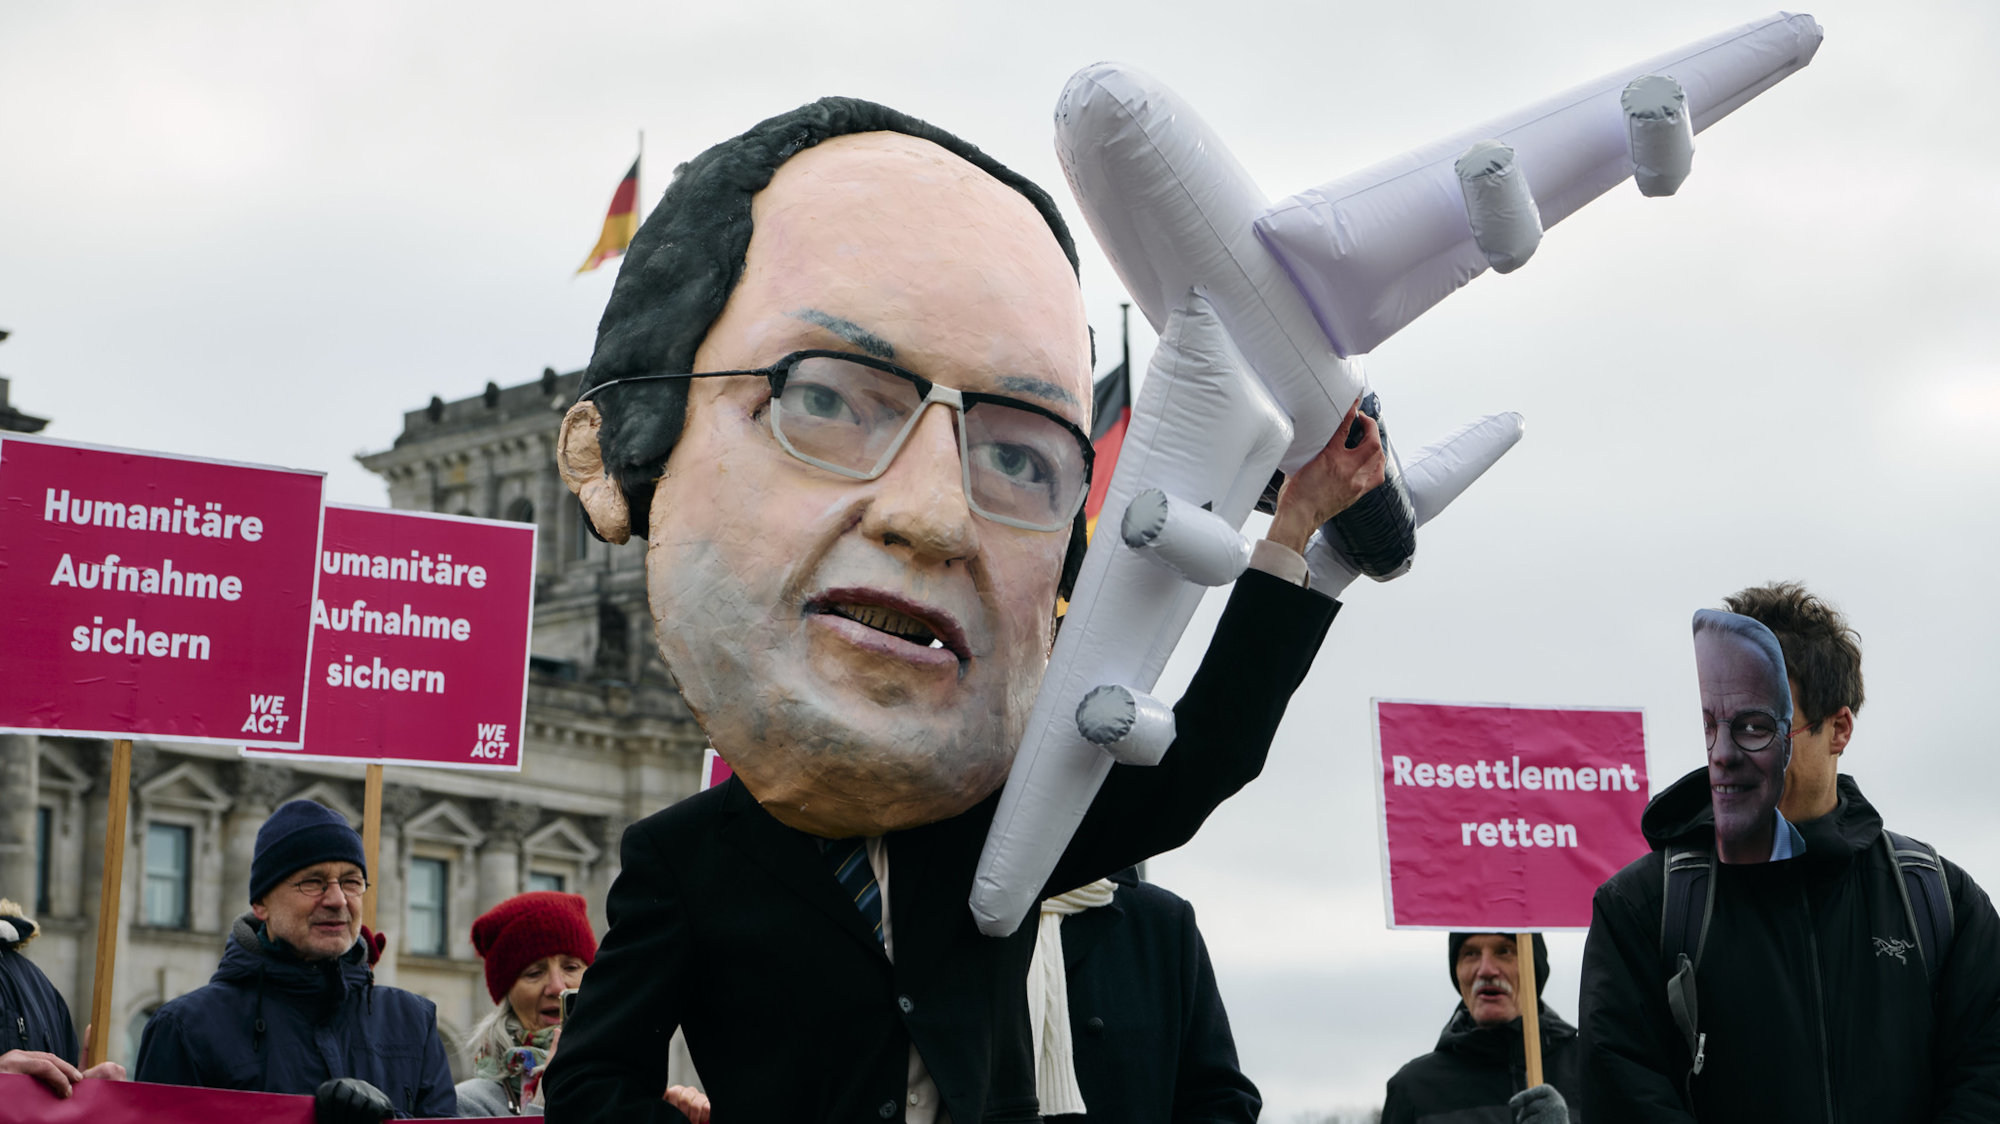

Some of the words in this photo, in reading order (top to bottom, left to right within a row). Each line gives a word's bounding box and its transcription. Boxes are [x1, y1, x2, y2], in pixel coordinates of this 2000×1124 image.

[44, 487, 263, 541] Humanitäre
[50, 553, 242, 601] Aufnahme
[323, 549, 487, 589] umanitäre
[70, 616, 211, 661] sichern
[313, 599, 471, 641] Aufnahme
[326, 654, 444, 693] sichern
[249, 693, 285, 715] WE
[477, 722, 507, 741] WE
[1391, 755, 1640, 792] Resettlement
[1460, 817, 1579, 848] retten
